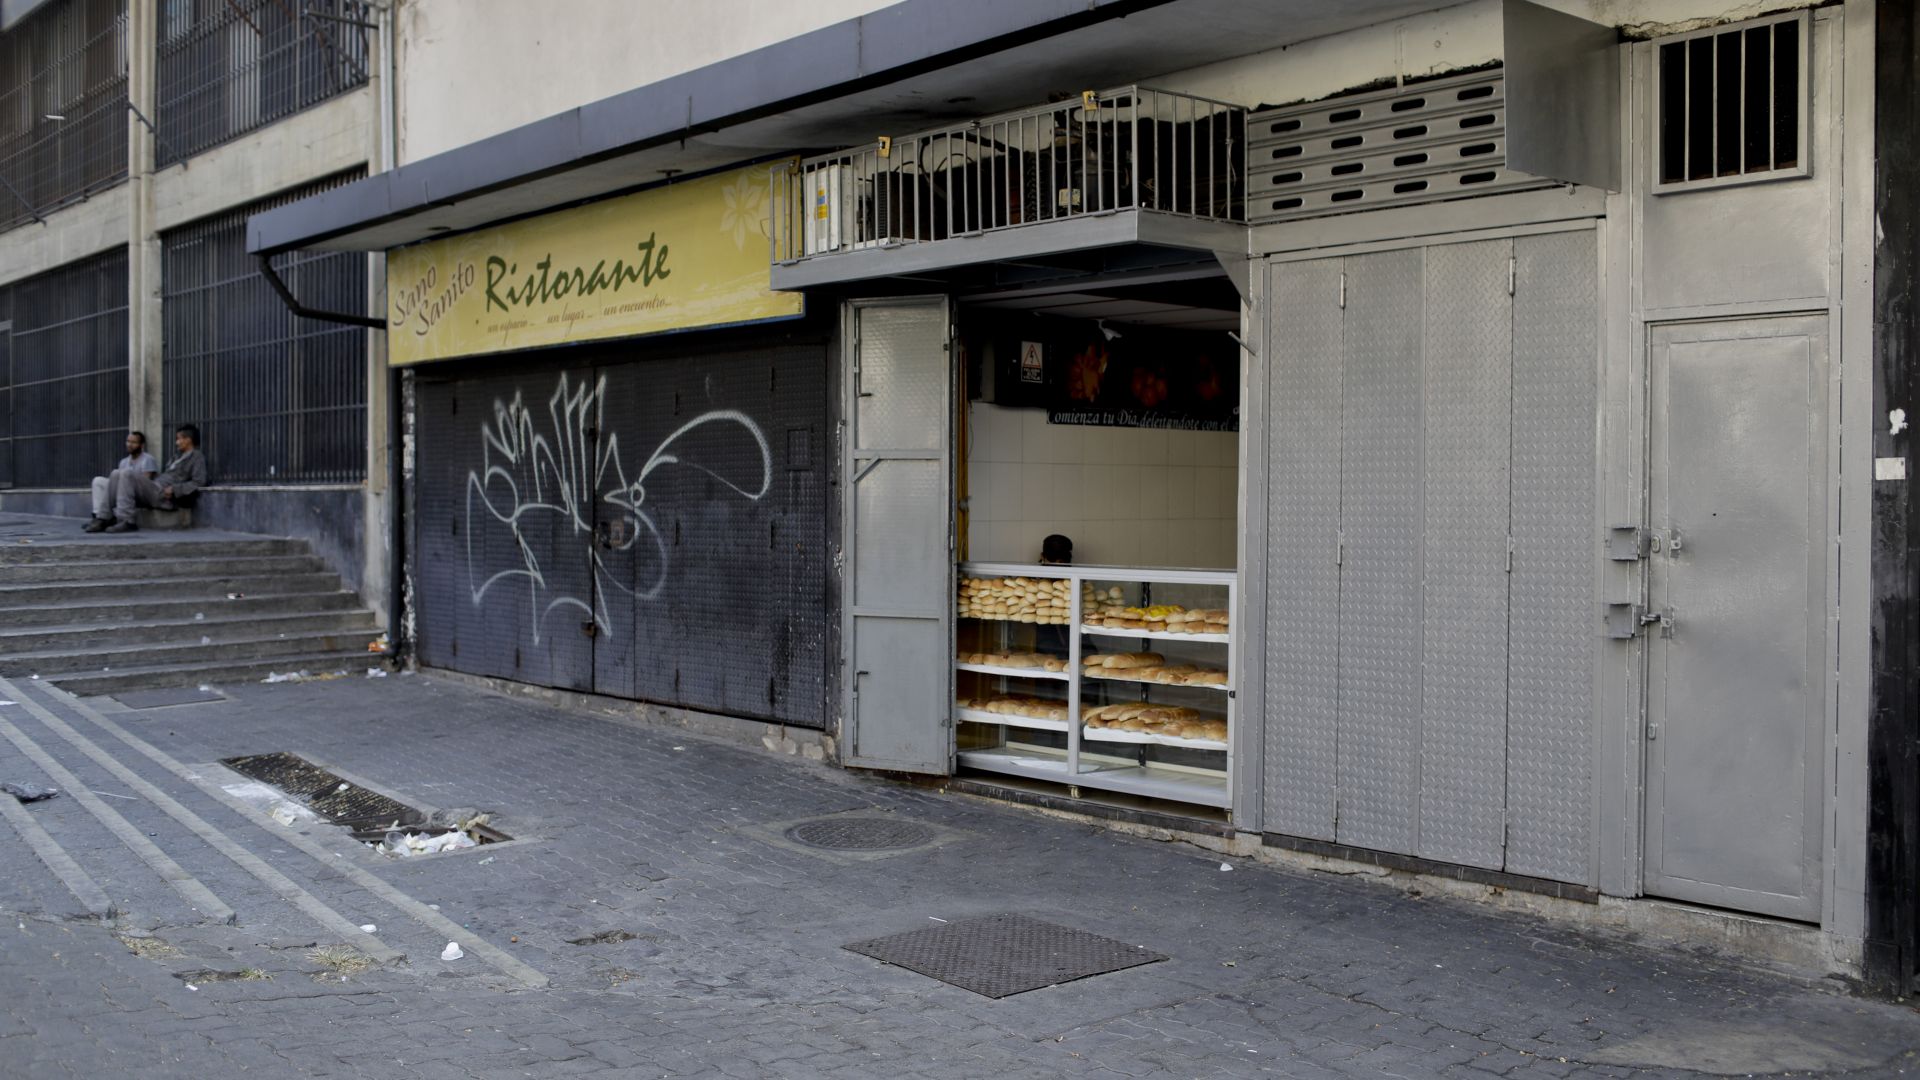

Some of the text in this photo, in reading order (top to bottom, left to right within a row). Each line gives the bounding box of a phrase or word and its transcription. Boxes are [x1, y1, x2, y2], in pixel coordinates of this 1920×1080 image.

[393, 266, 436, 326] Sano
[416, 262, 474, 336] Sanito
[486, 231, 671, 313] Ristorante
[603, 306, 617, 316] un
[1103, 412, 1115, 424] tu
